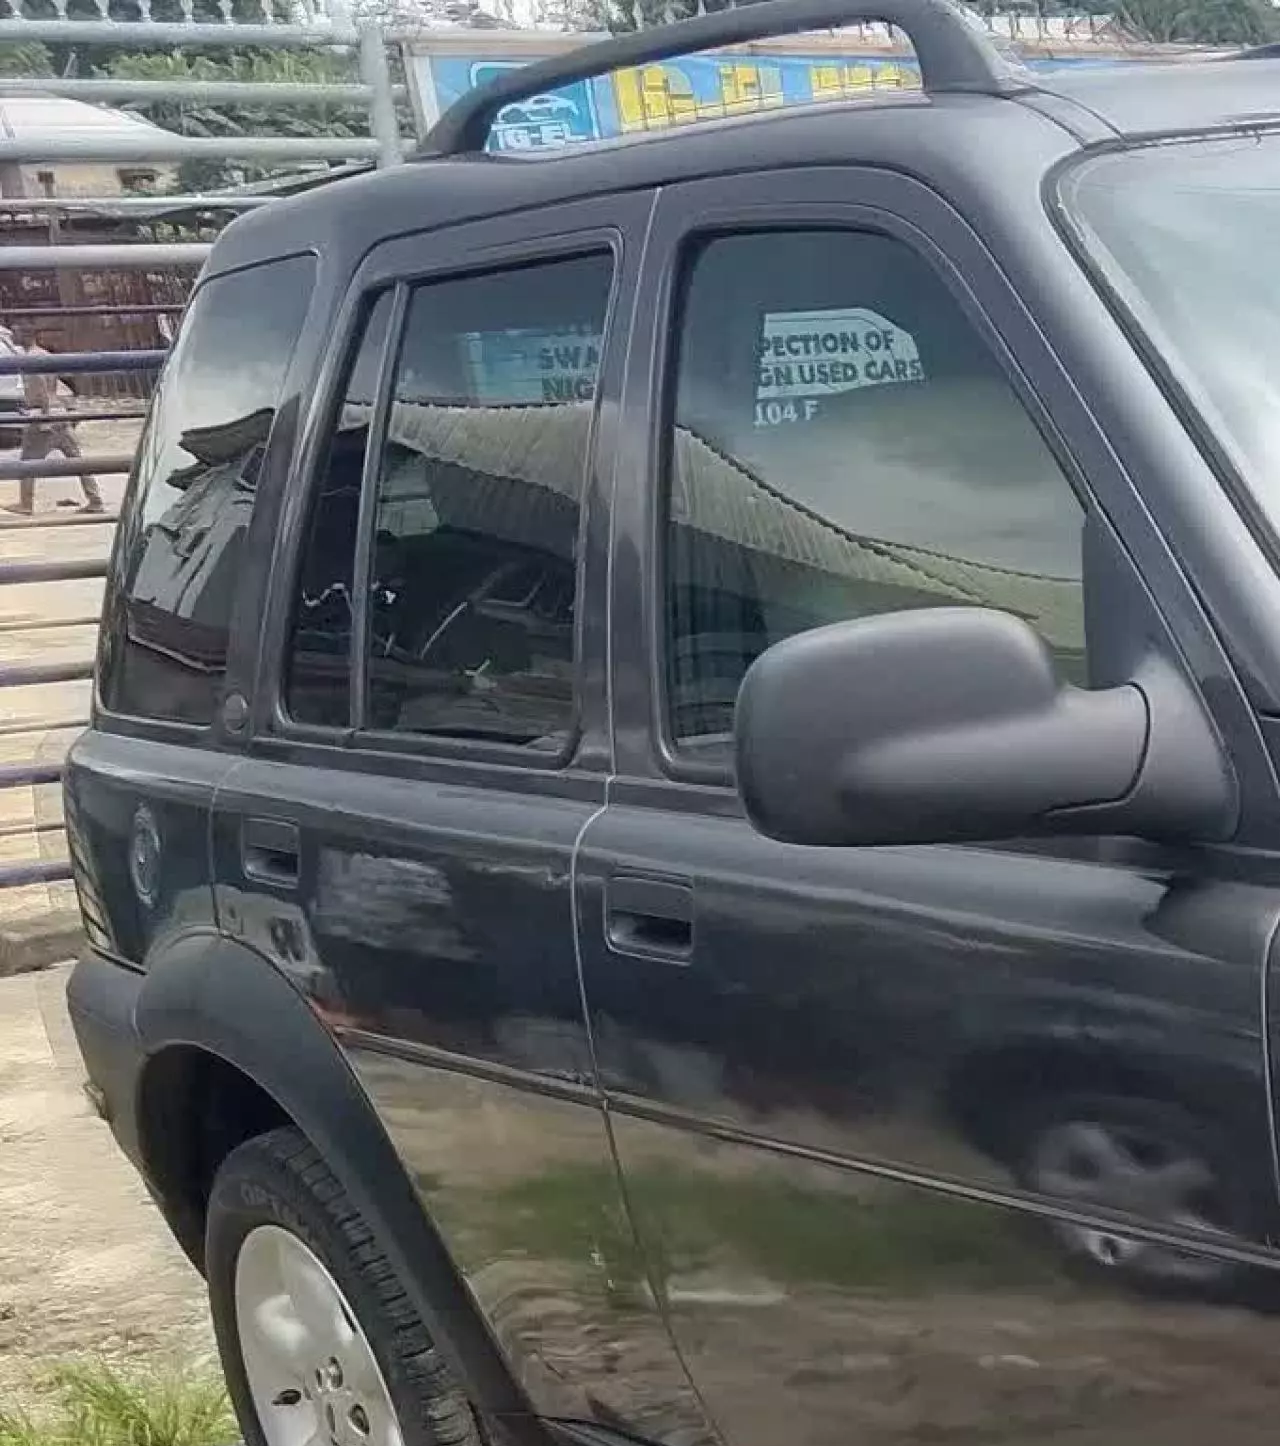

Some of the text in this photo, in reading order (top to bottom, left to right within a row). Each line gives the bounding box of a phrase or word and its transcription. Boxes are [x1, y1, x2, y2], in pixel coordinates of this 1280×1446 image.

[864, 328, 895, 352] OF
[799, 361, 858, 386] USED
[864, 359, 922, 382] CARS
